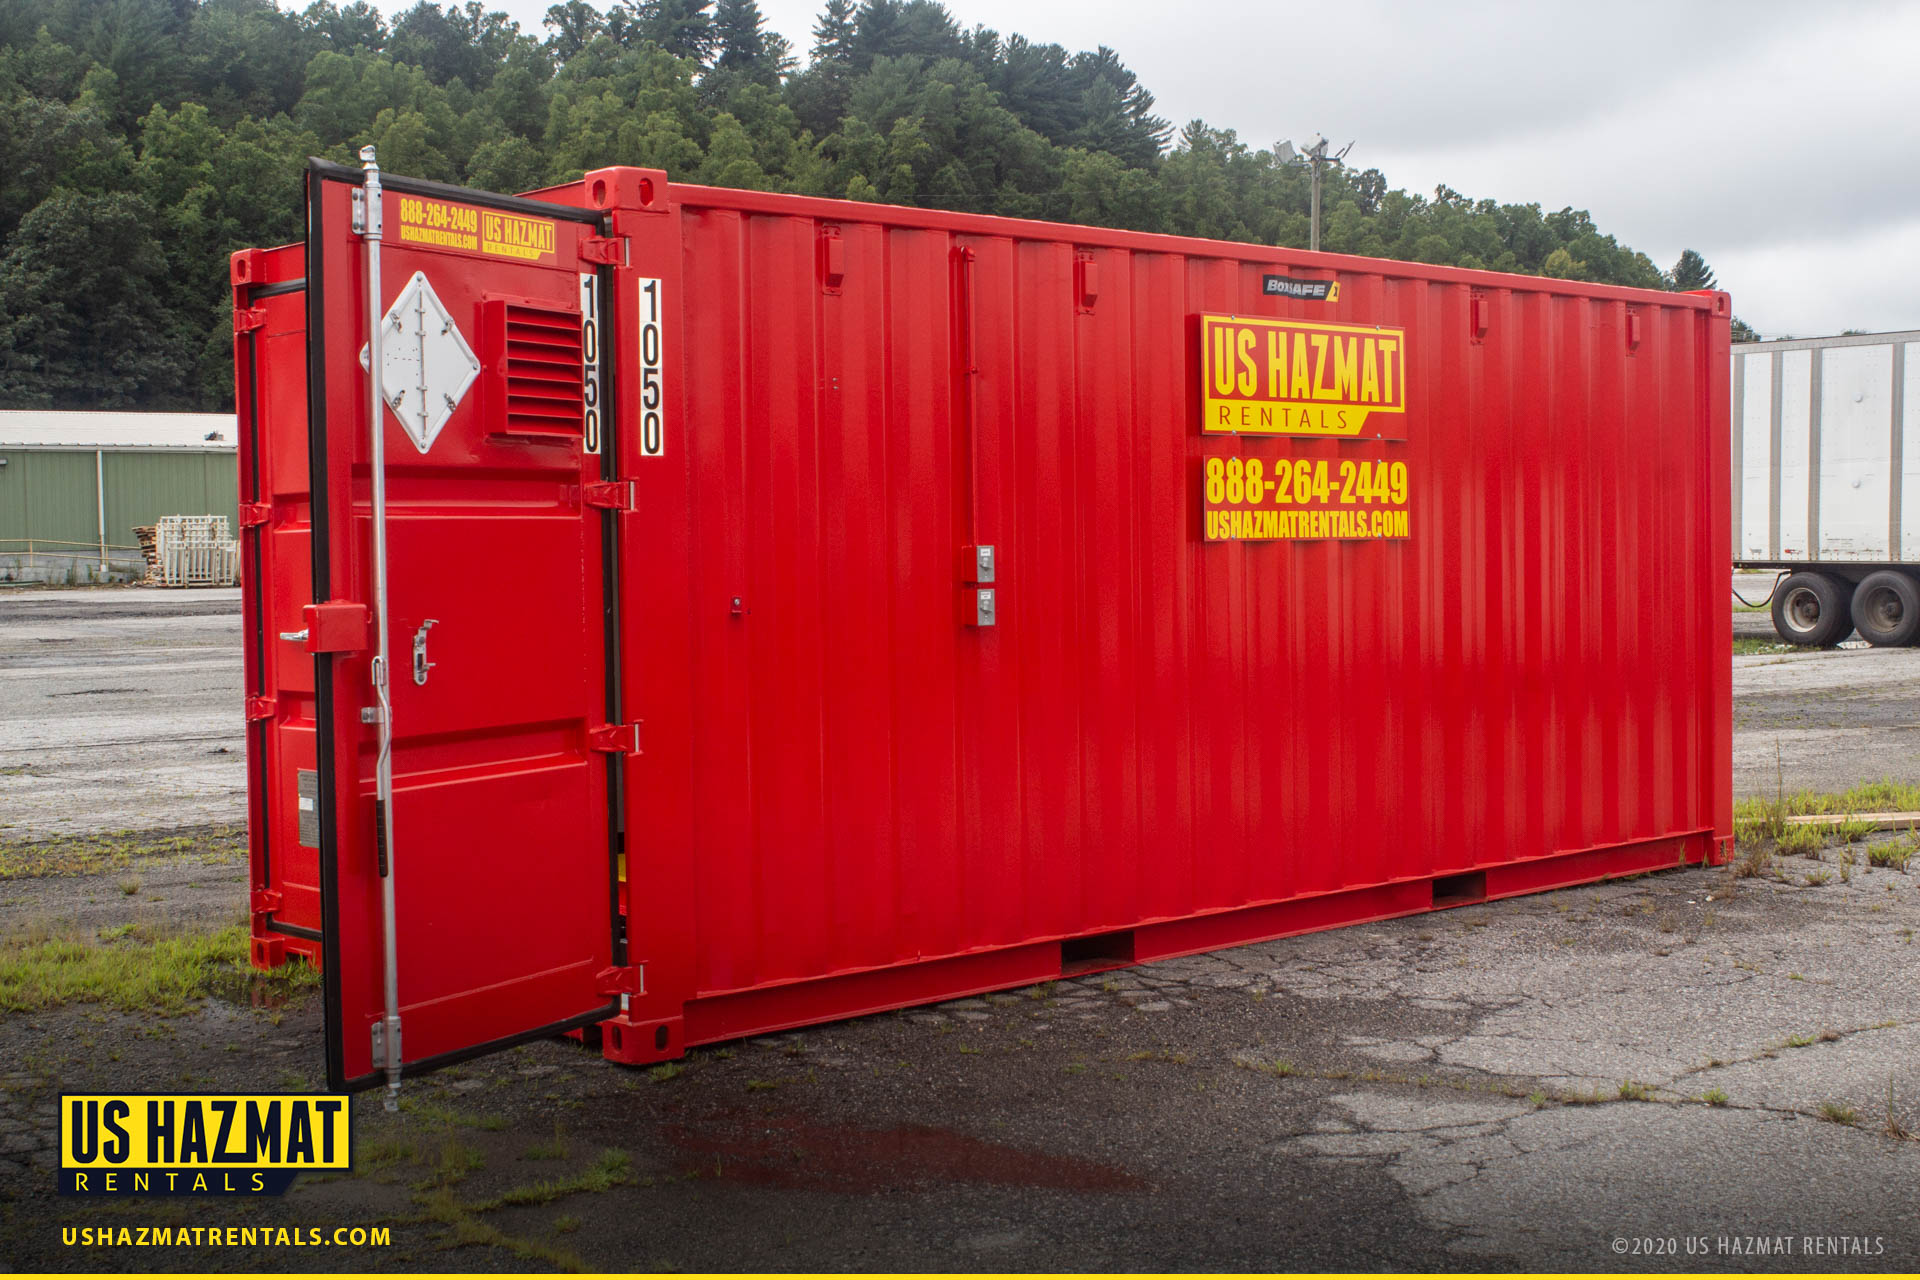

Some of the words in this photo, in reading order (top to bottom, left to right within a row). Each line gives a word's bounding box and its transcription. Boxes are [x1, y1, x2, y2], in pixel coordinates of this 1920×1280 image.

[400, 198, 478, 233] 888-264-2449
[485, 215, 501, 242] US
[504, 218, 551, 249] HAZMAT
[400, 225, 478, 250] USHAZMATRENTALS.COM
[487, 243, 534, 257] RENTALS
[583, 275, 598, 453] 1050
[643, 280, 660, 454] 1050
[1214, 326, 1257, 397] US
[1268, 330, 1397, 403] HAZMAT
[1219, 405, 1348, 429] RENTALS
[1206, 457, 1408, 505] 888-264-2449
[1206, 509, 1409, 540] USHAZMATRENTALS.COM
